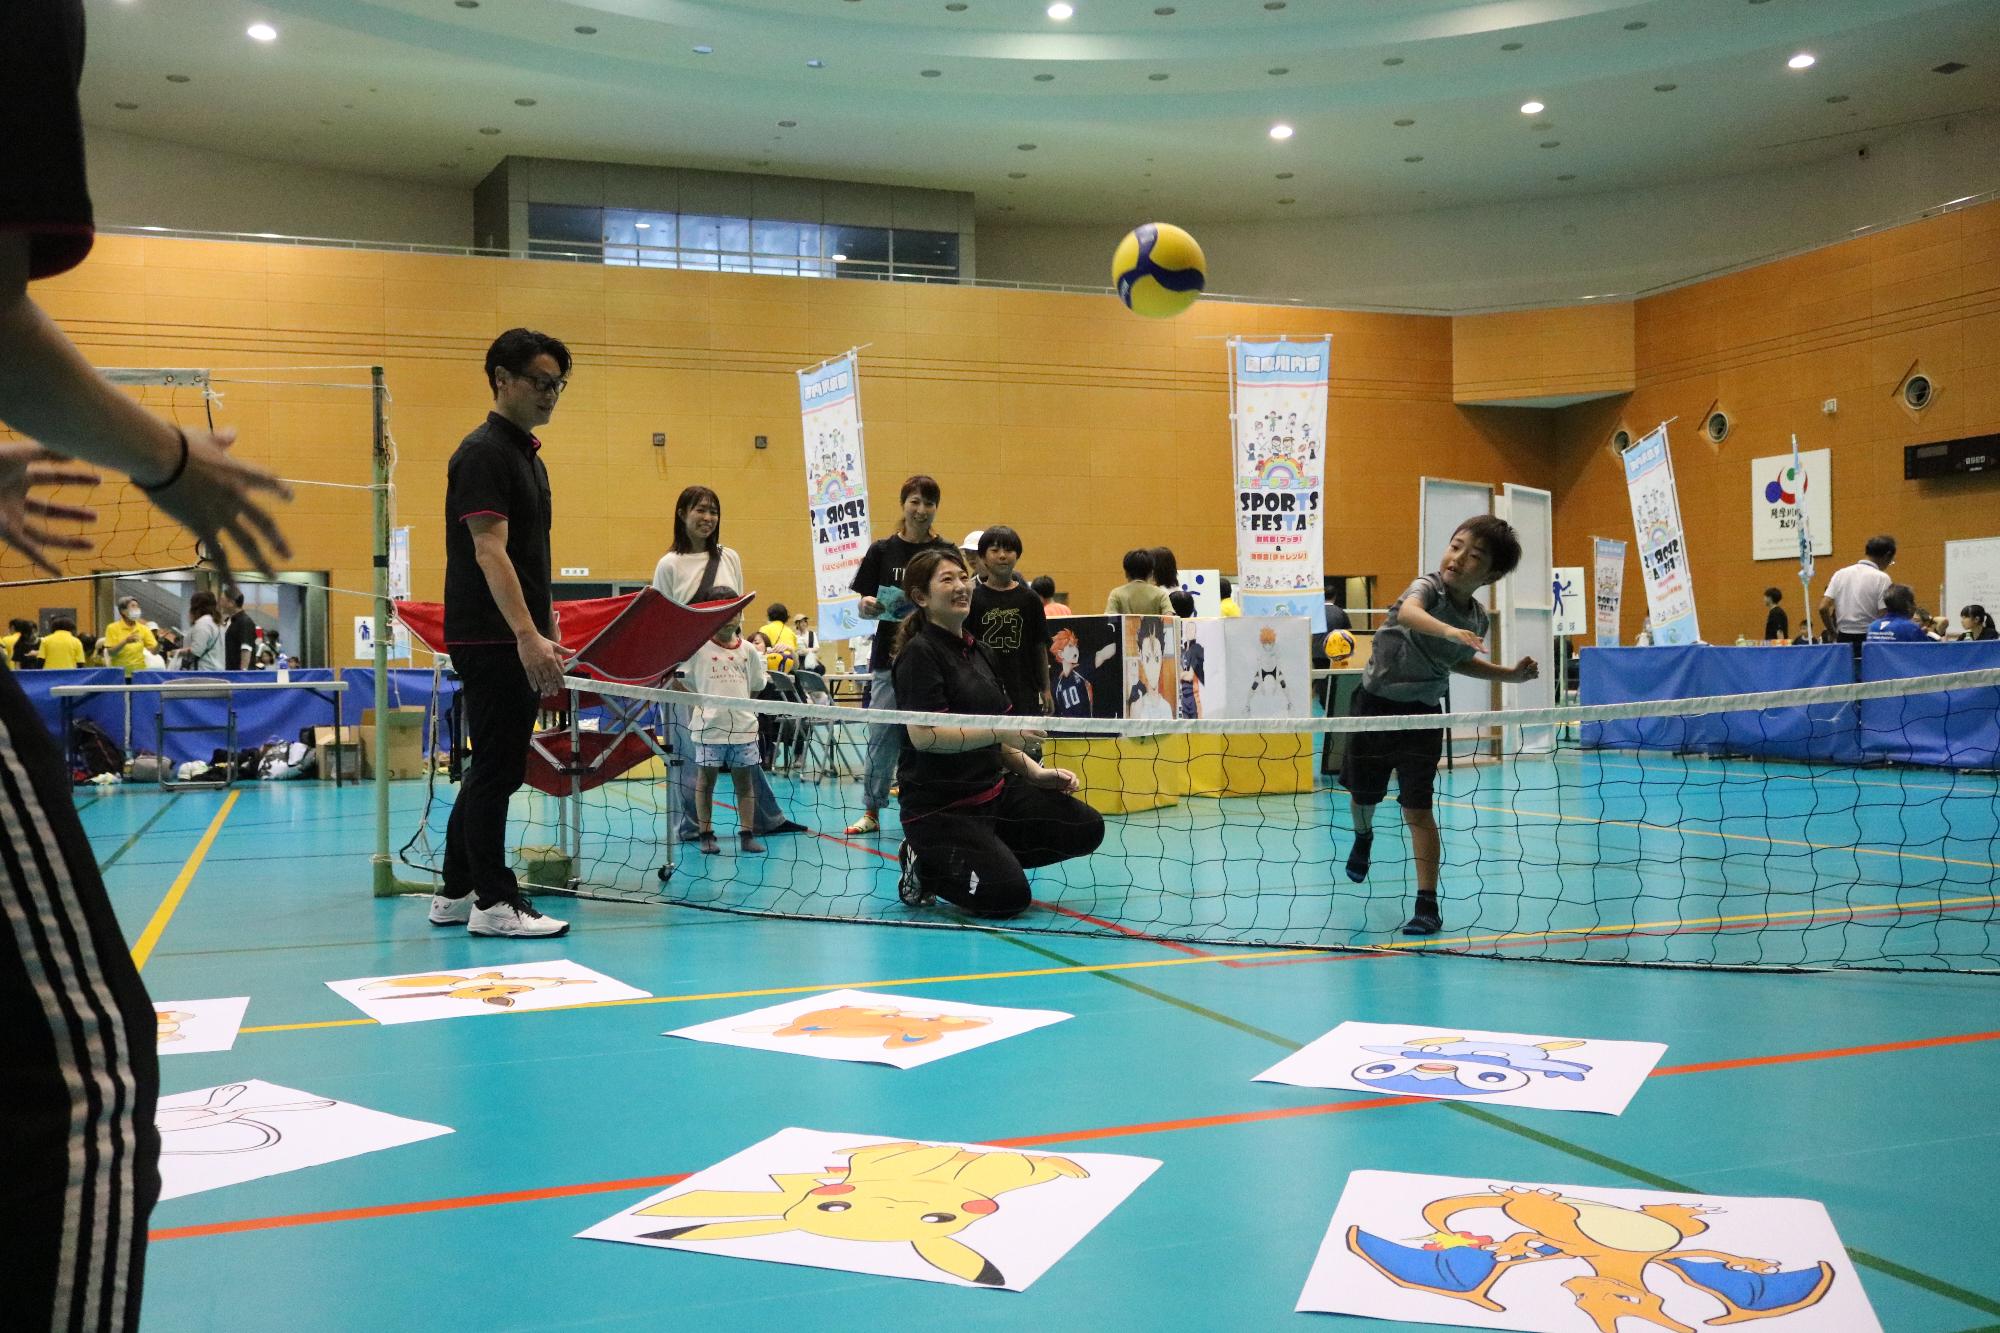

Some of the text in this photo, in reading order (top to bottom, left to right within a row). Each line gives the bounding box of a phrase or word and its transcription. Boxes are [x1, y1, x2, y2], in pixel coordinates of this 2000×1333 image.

[1240, 491, 1319, 511] SPORTS
[1251, 514, 1307, 531] FESTA
[982, 613, 1024, 649] 23
[1063, 685, 1081, 709] 10
